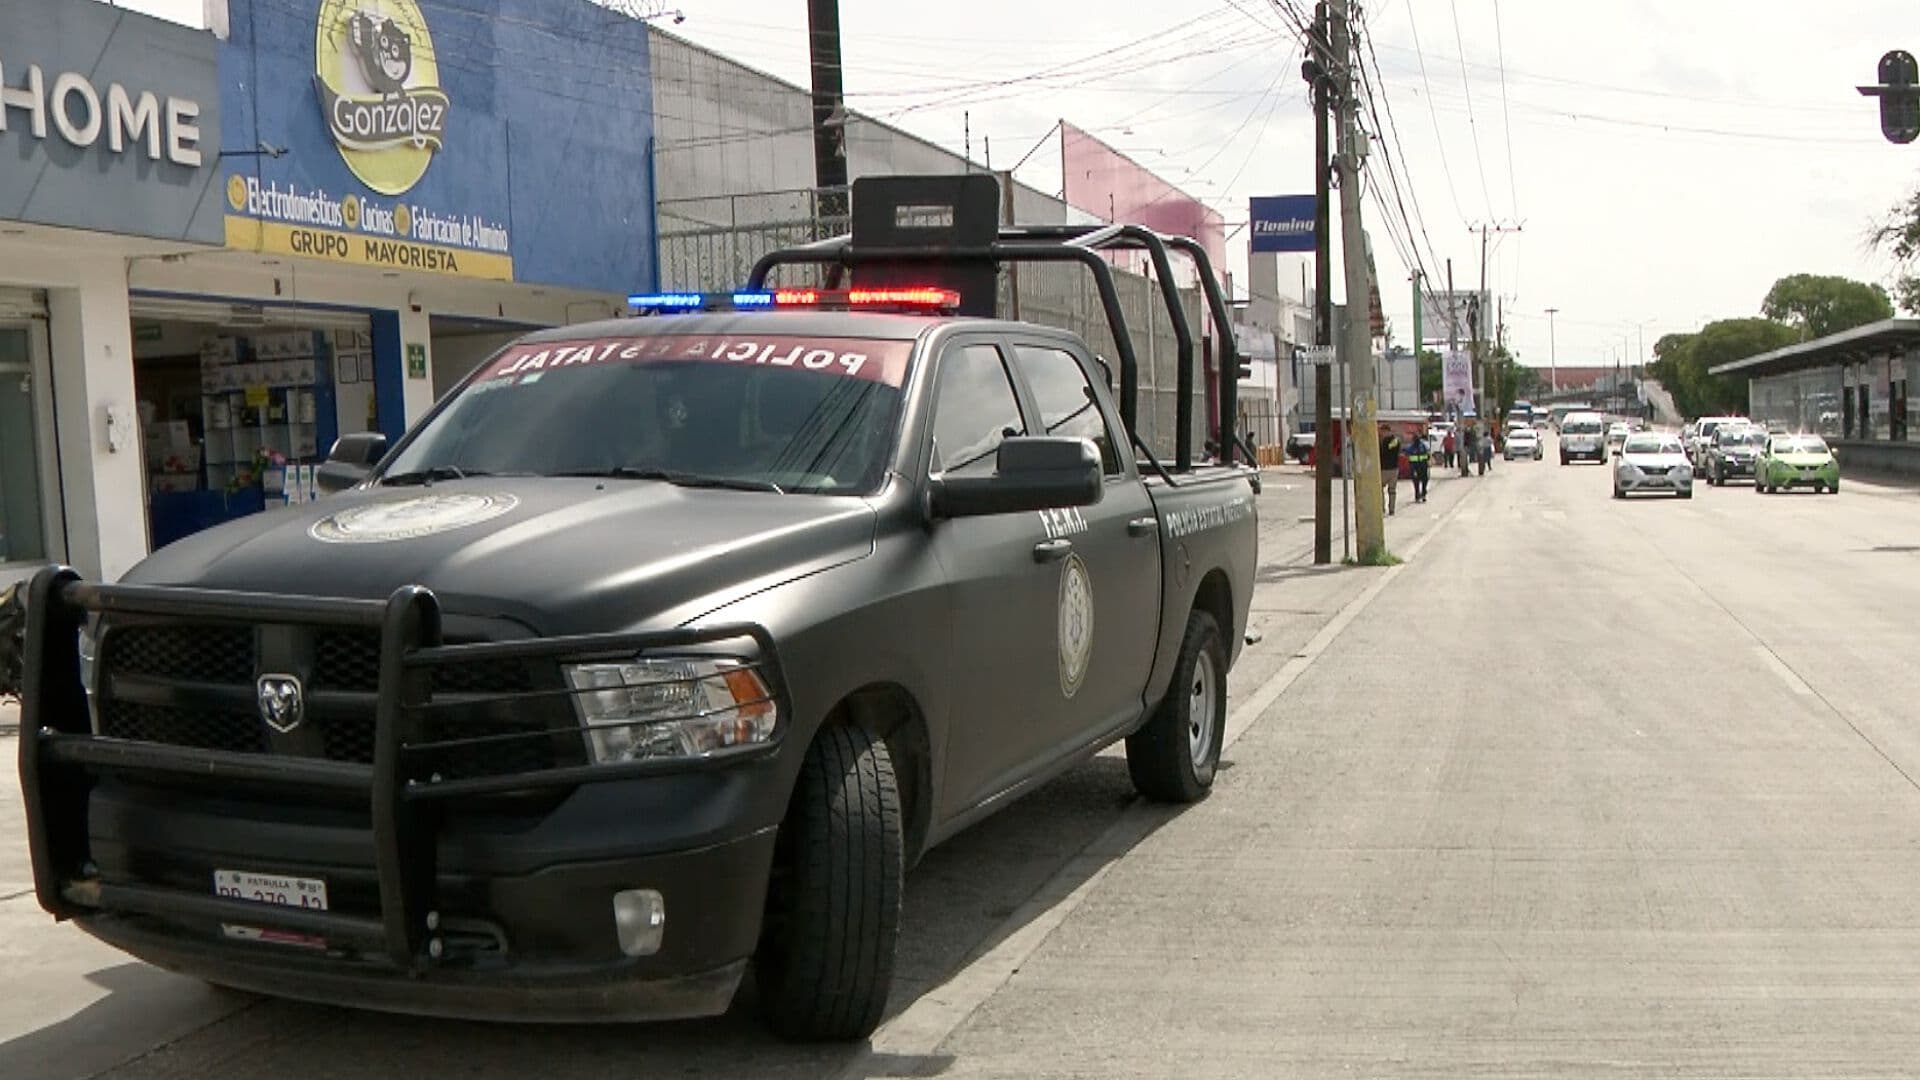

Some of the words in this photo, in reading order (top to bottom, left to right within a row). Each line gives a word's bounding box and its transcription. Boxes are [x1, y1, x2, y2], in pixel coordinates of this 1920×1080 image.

[0, 60, 201, 167] HOME
[246, 176, 343, 227] Electrodomésticos
[360, 196, 395, 236] Cocinas
[411, 205, 461, 245] Fabricación
[462, 214, 472, 247] de
[472, 215, 508, 251] Aluminio
[1254, 217, 1316, 233] Fleming
[290, 230, 349, 258] GRUPO
[364, 239, 458, 272] MAYORISTA
[247, 878, 290, 888] PATRULLA
